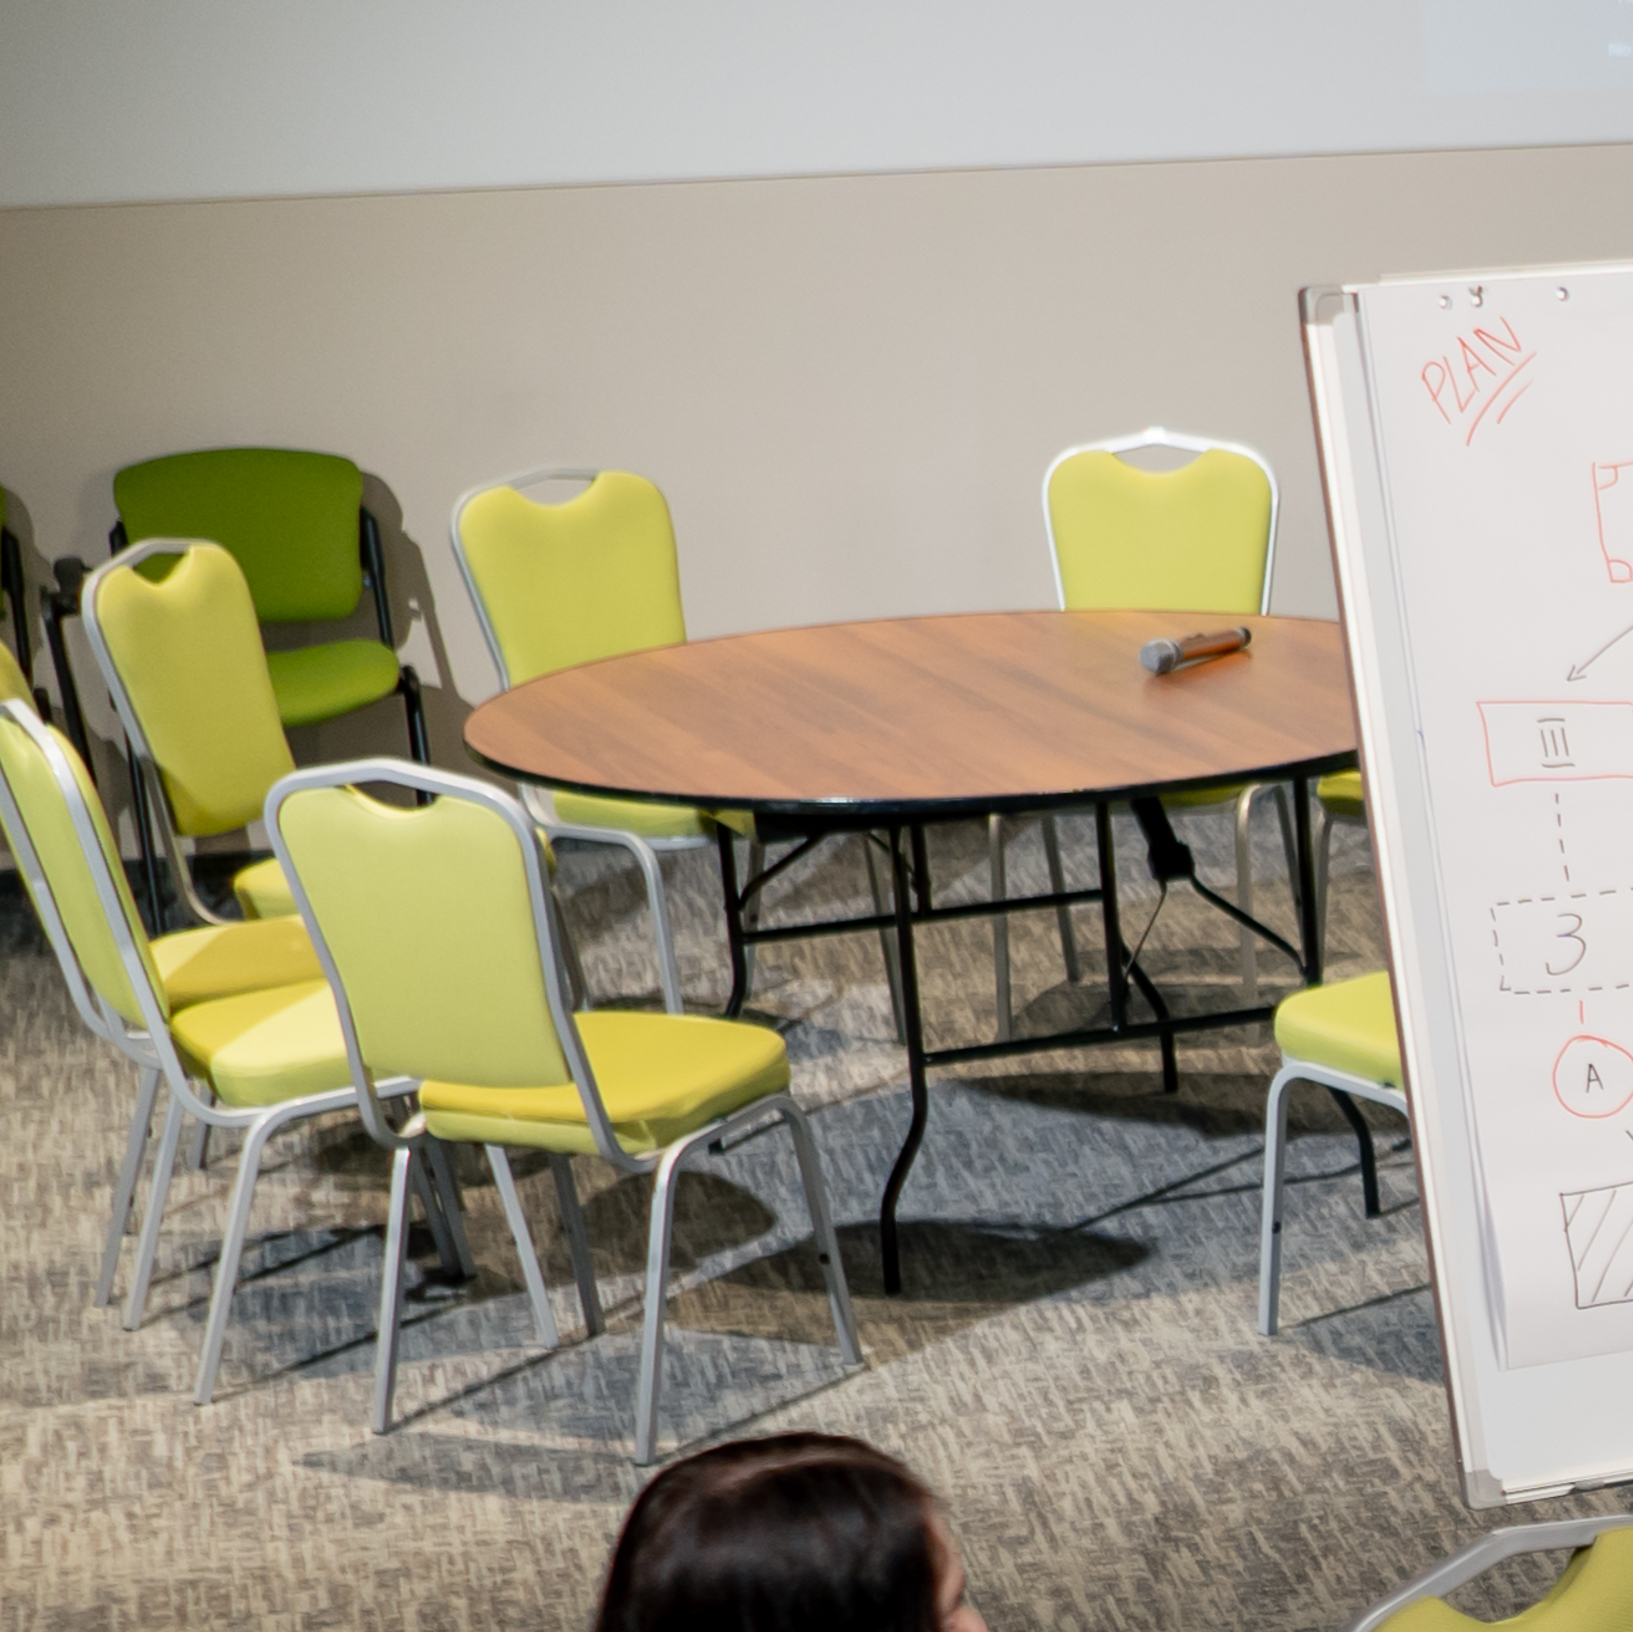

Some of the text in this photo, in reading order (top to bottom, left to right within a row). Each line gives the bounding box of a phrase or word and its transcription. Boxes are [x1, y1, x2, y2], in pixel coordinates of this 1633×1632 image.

[1421, 317, 1524, 424] PLAN
[1544, 912, 1587, 977] 3
[1584, 1062, 1604, 1094] A
